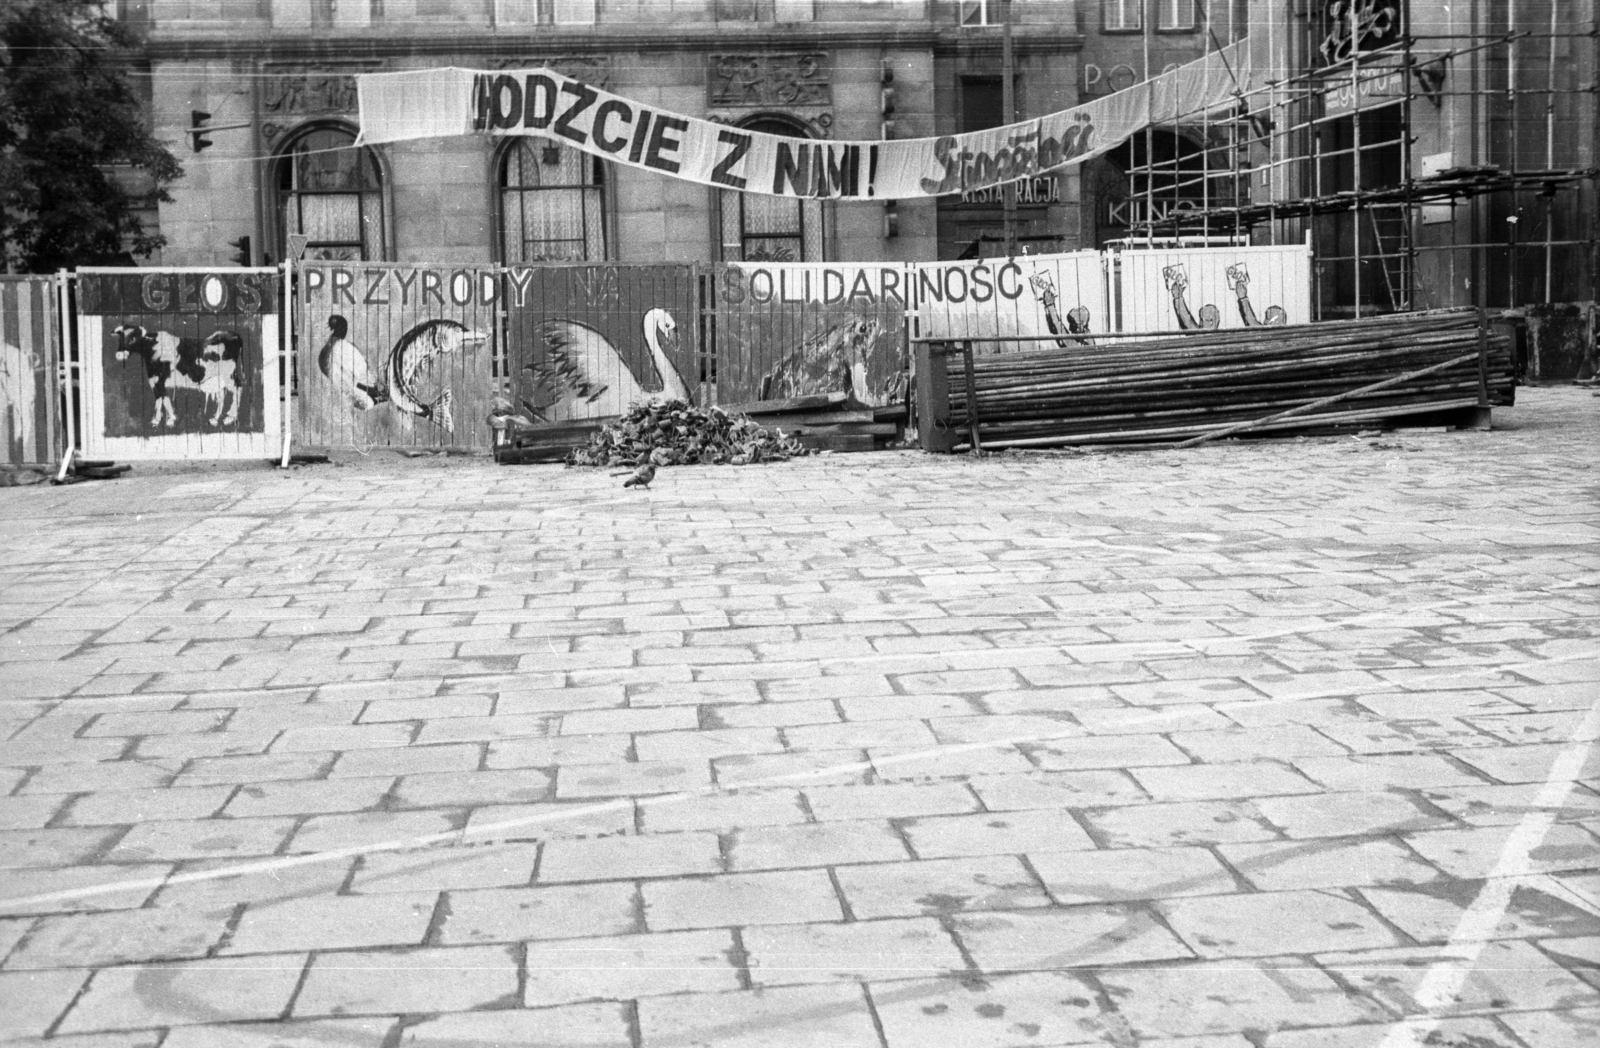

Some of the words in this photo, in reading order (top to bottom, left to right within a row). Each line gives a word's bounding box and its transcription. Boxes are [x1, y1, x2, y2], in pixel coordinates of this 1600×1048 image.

[711, 129, 752, 189] Z
[962, 176, 1060, 203] RESTARACJA
[142, 272, 262, 312] GŁOS
[305, 267, 538, 307] PRZYRODY
[722, 256, 1024, 304] SOLIDARNOŚĆ
